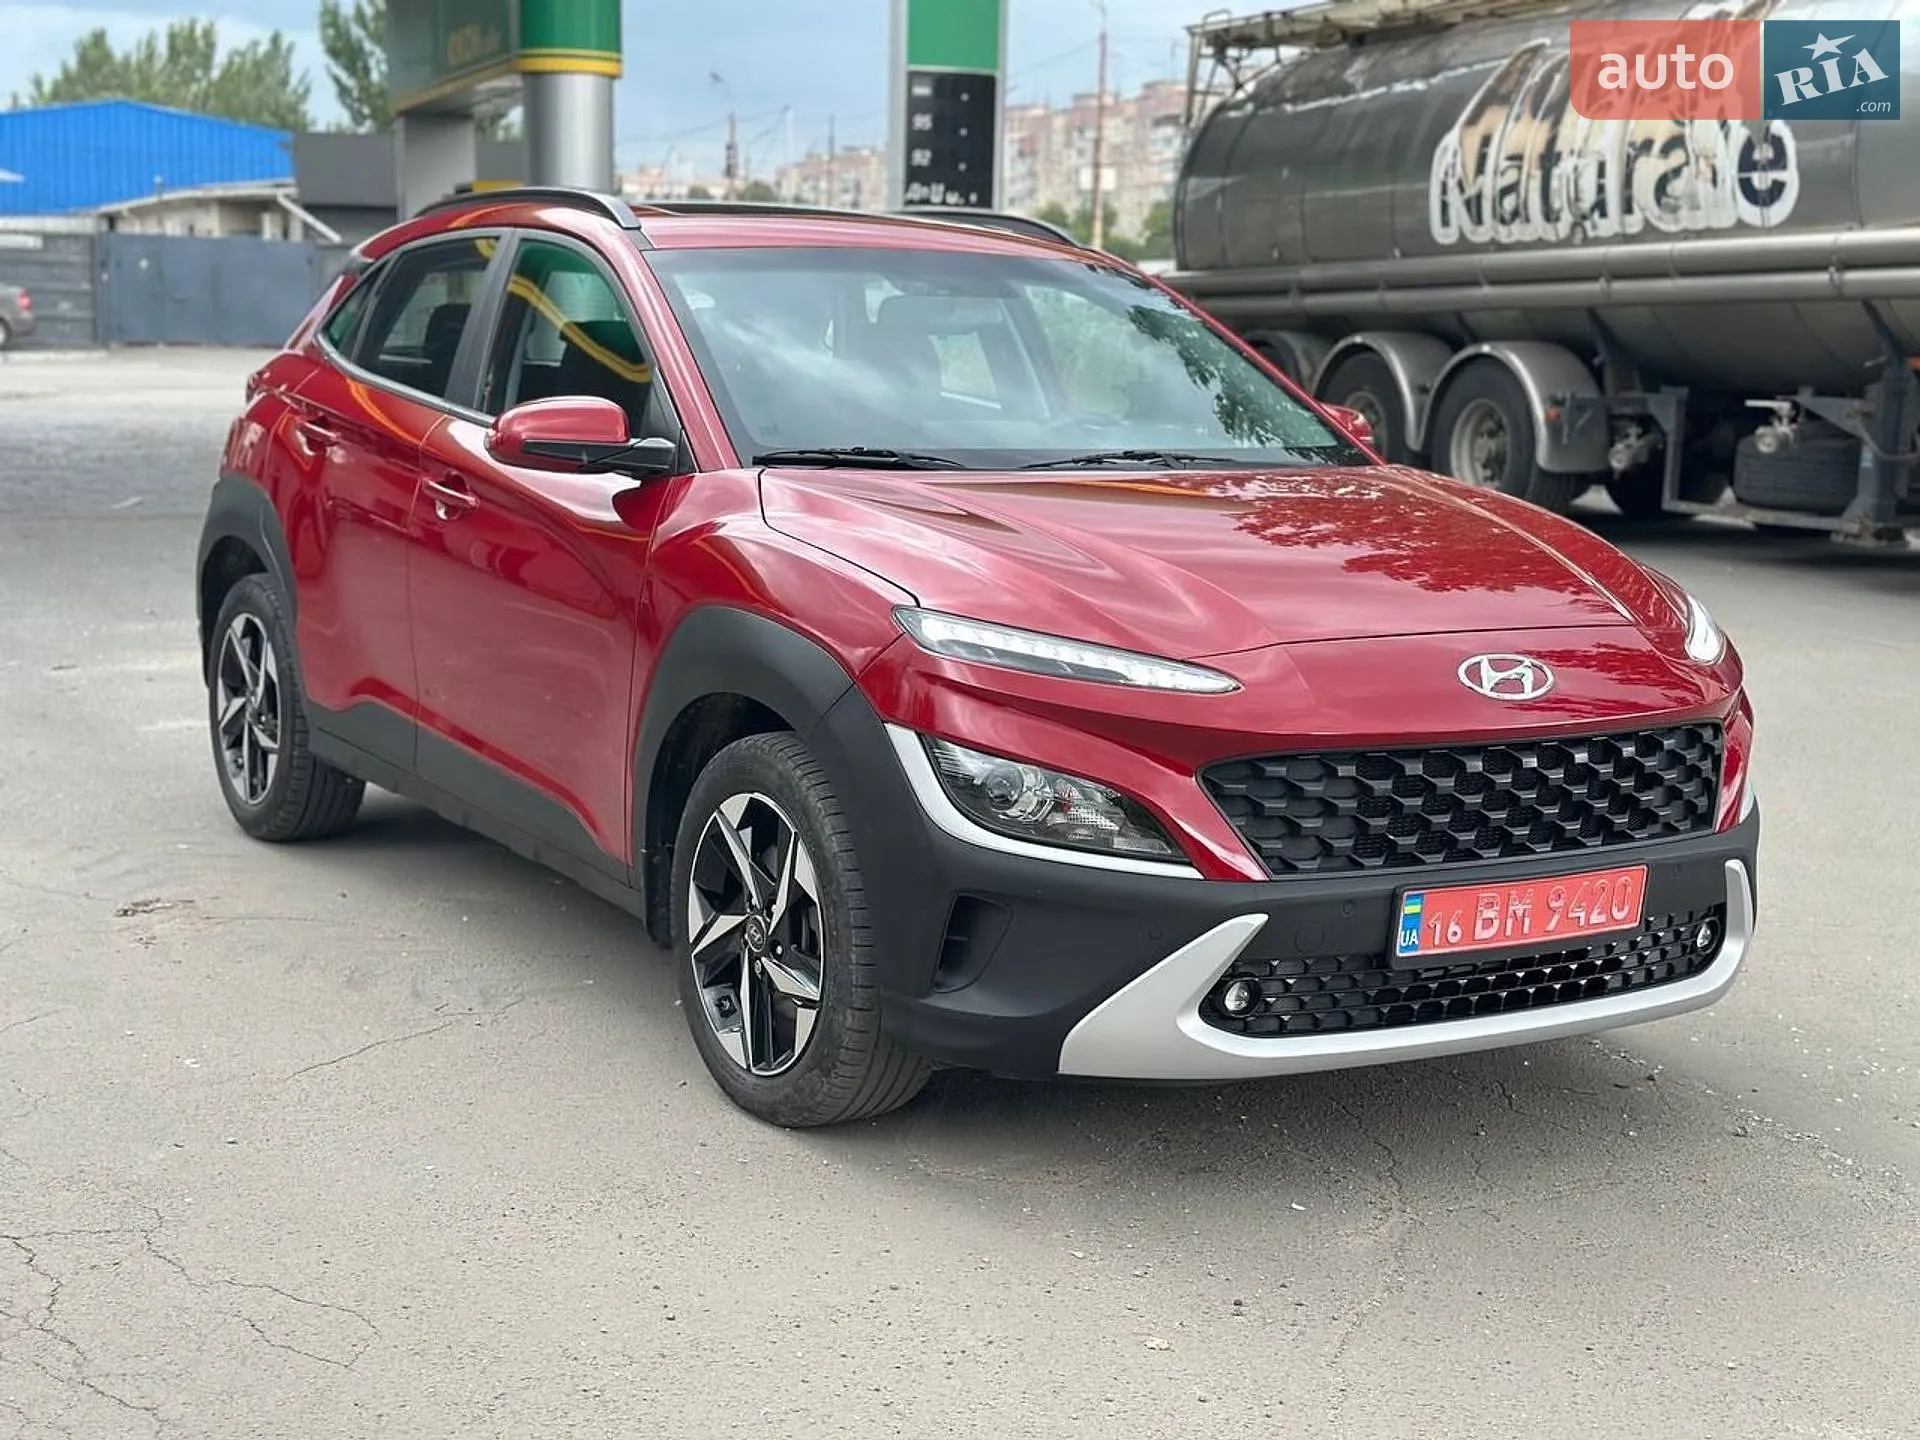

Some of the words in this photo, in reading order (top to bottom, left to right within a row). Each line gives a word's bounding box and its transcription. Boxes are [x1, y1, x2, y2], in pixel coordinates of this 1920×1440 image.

[1430, 118, 1800, 244] Naturae
[1399, 928, 1420, 947] UA
[1428, 910, 1464, 946] 16
[1543, 875, 1634, 932] 9420
